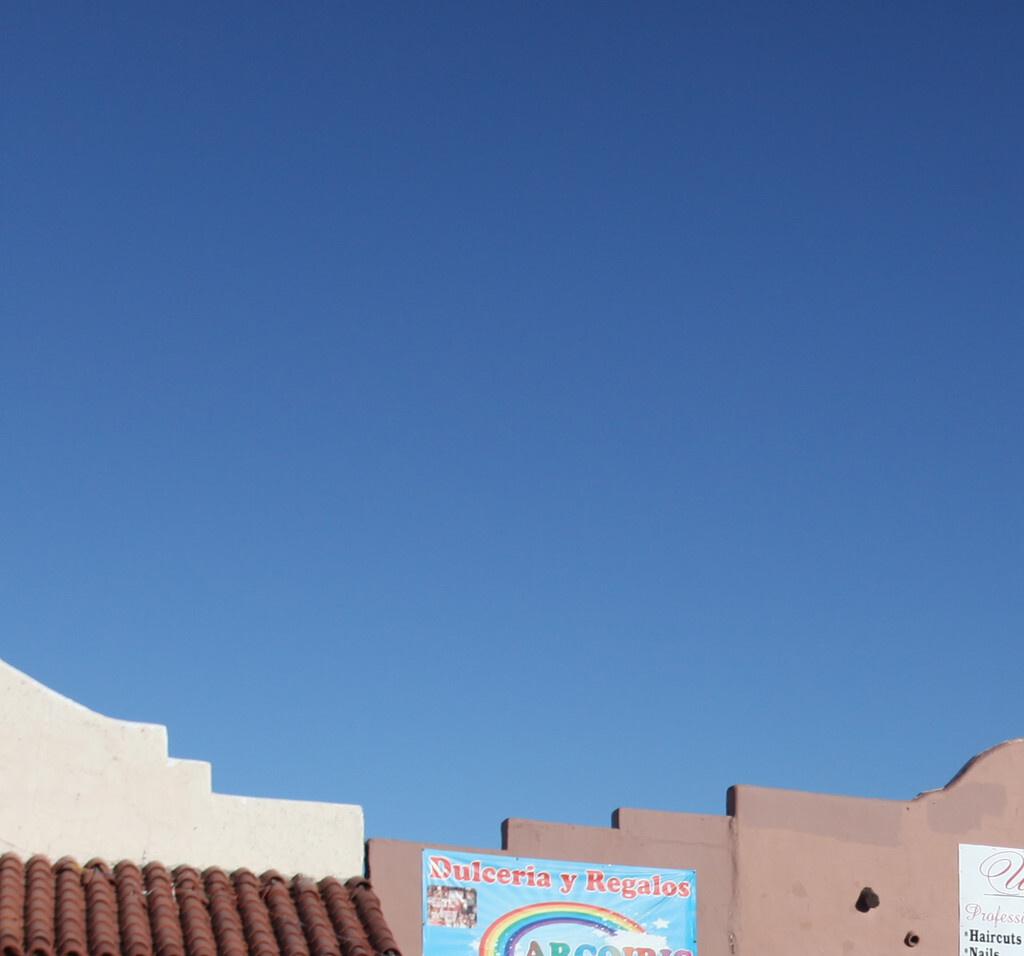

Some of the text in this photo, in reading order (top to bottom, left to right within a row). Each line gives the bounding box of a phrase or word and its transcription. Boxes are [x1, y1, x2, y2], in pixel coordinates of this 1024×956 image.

[429, 857, 690, 898] Dulceria y Regalos
[970, 929, 1022, 945] Haircuts
